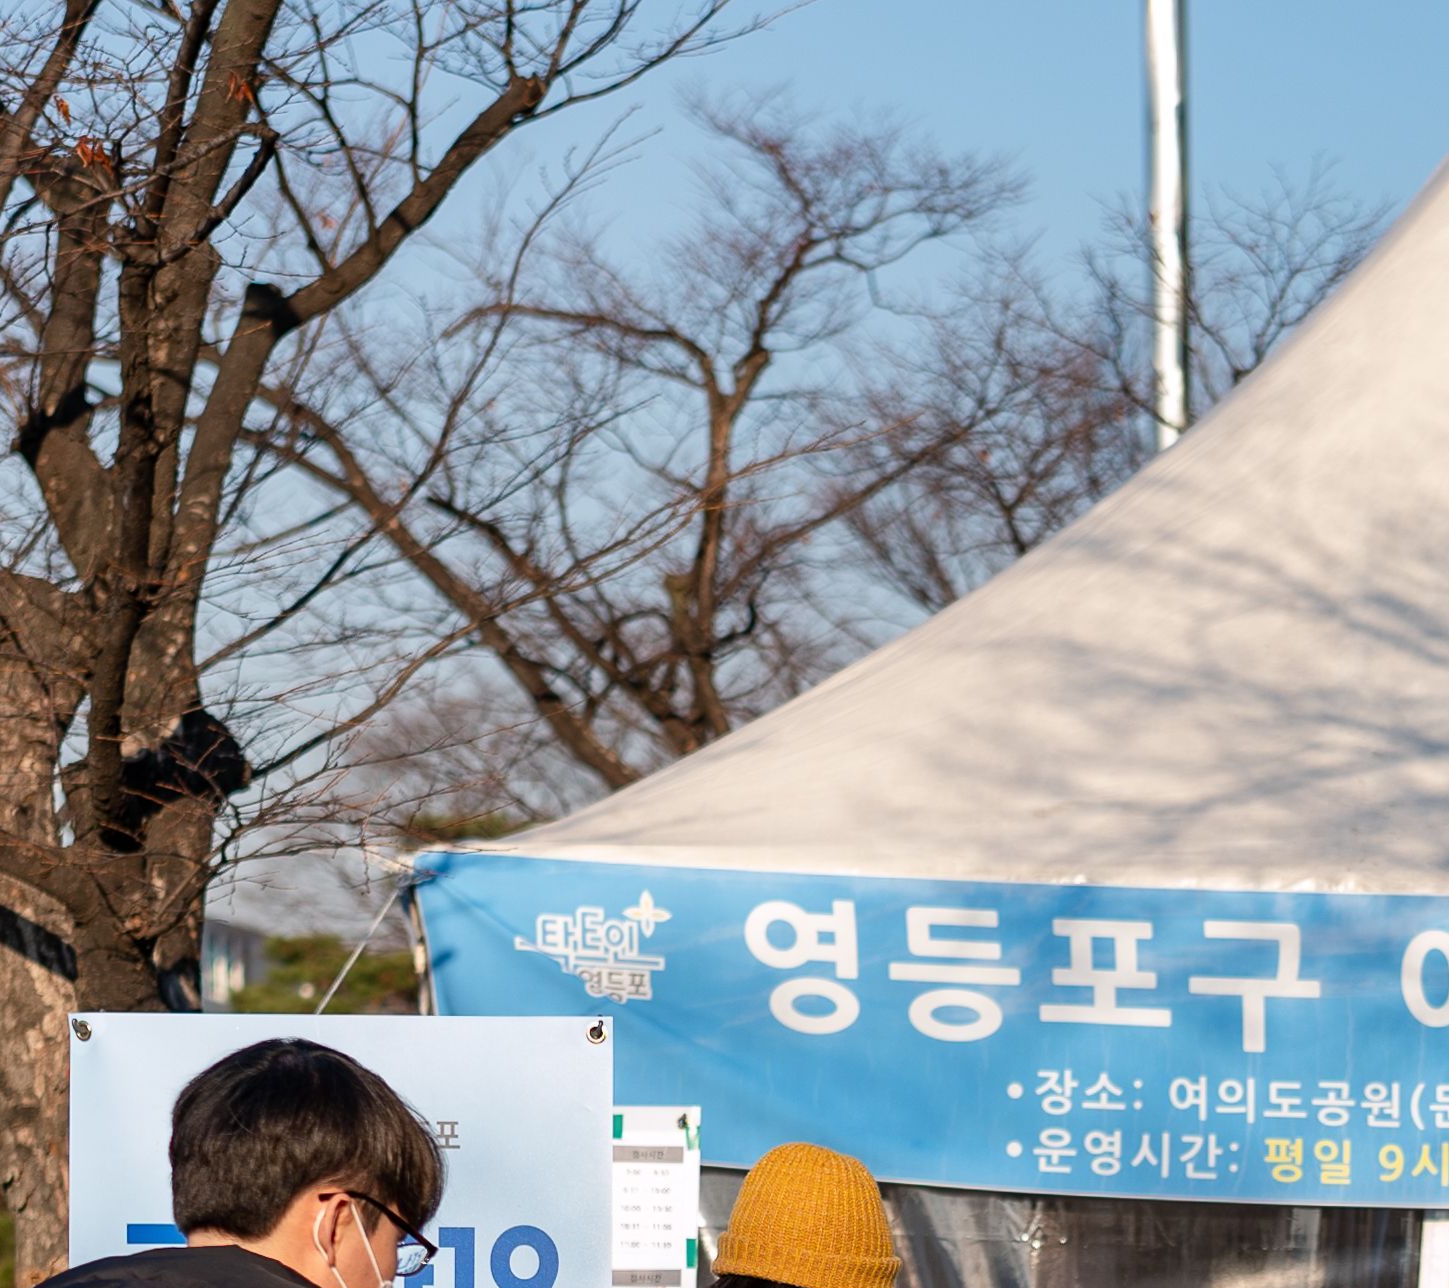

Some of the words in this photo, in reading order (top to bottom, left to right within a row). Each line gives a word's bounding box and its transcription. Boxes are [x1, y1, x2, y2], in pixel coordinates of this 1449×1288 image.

[578, 970, 651, 1003] 영등포
[744, 899, 1321, 1053] 영등포구
[1035, 1069, 1143, 1116] 장소:
[1032, 1129, 1240, 1179] 운영시간:
[1264, 1138, 1353, 1185] 평일
